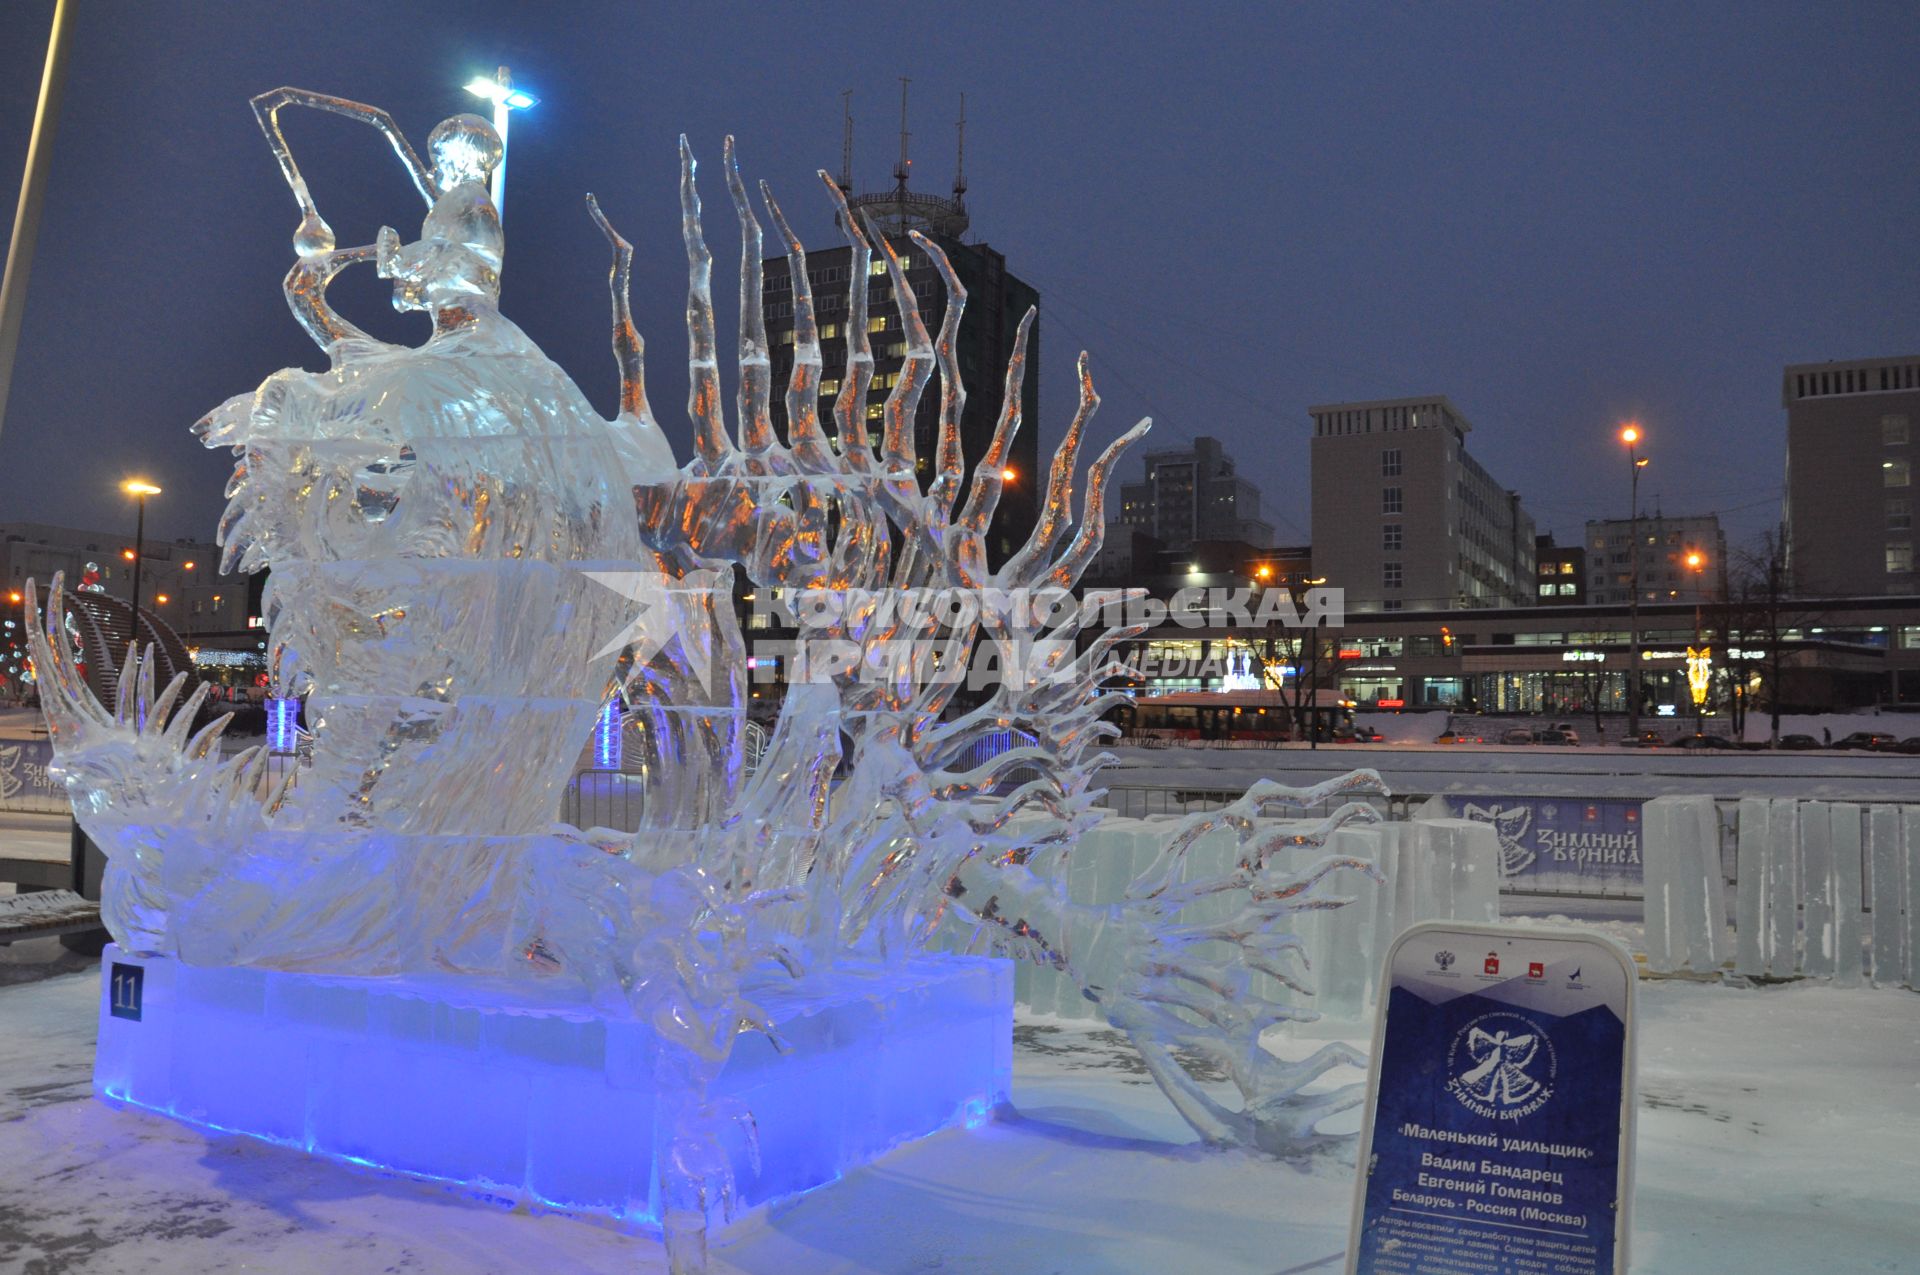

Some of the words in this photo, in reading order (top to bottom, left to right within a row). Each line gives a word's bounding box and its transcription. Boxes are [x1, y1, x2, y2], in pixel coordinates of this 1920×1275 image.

[1553, 847, 1642, 871] ВЕРНИСА
[114, 974, 138, 1010] 11
[1397, 1122, 1498, 1147] «Маленький
[1502, 1138, 1594, 1159] удильщик»
[1421, 1152, 1476, 1172] Вадим
[1481, 1160, 1564, 1185] Бандарец
[1417, 1172, 1486, 1195] Евгений
[1490, 1183, 1563, 1205] Гоманов
[1392, 1189, 1456, 1208] Беларусь
[1466, 1199, 1517, 1217] Россия
[1520, 1207, 1587, 1228] (Москва)
[1376, 1236, 1446, 1253] теизионных
[1379, 1215, 1411, 1228] Авторы
[1481, 1231, 1511, 1243] работу
